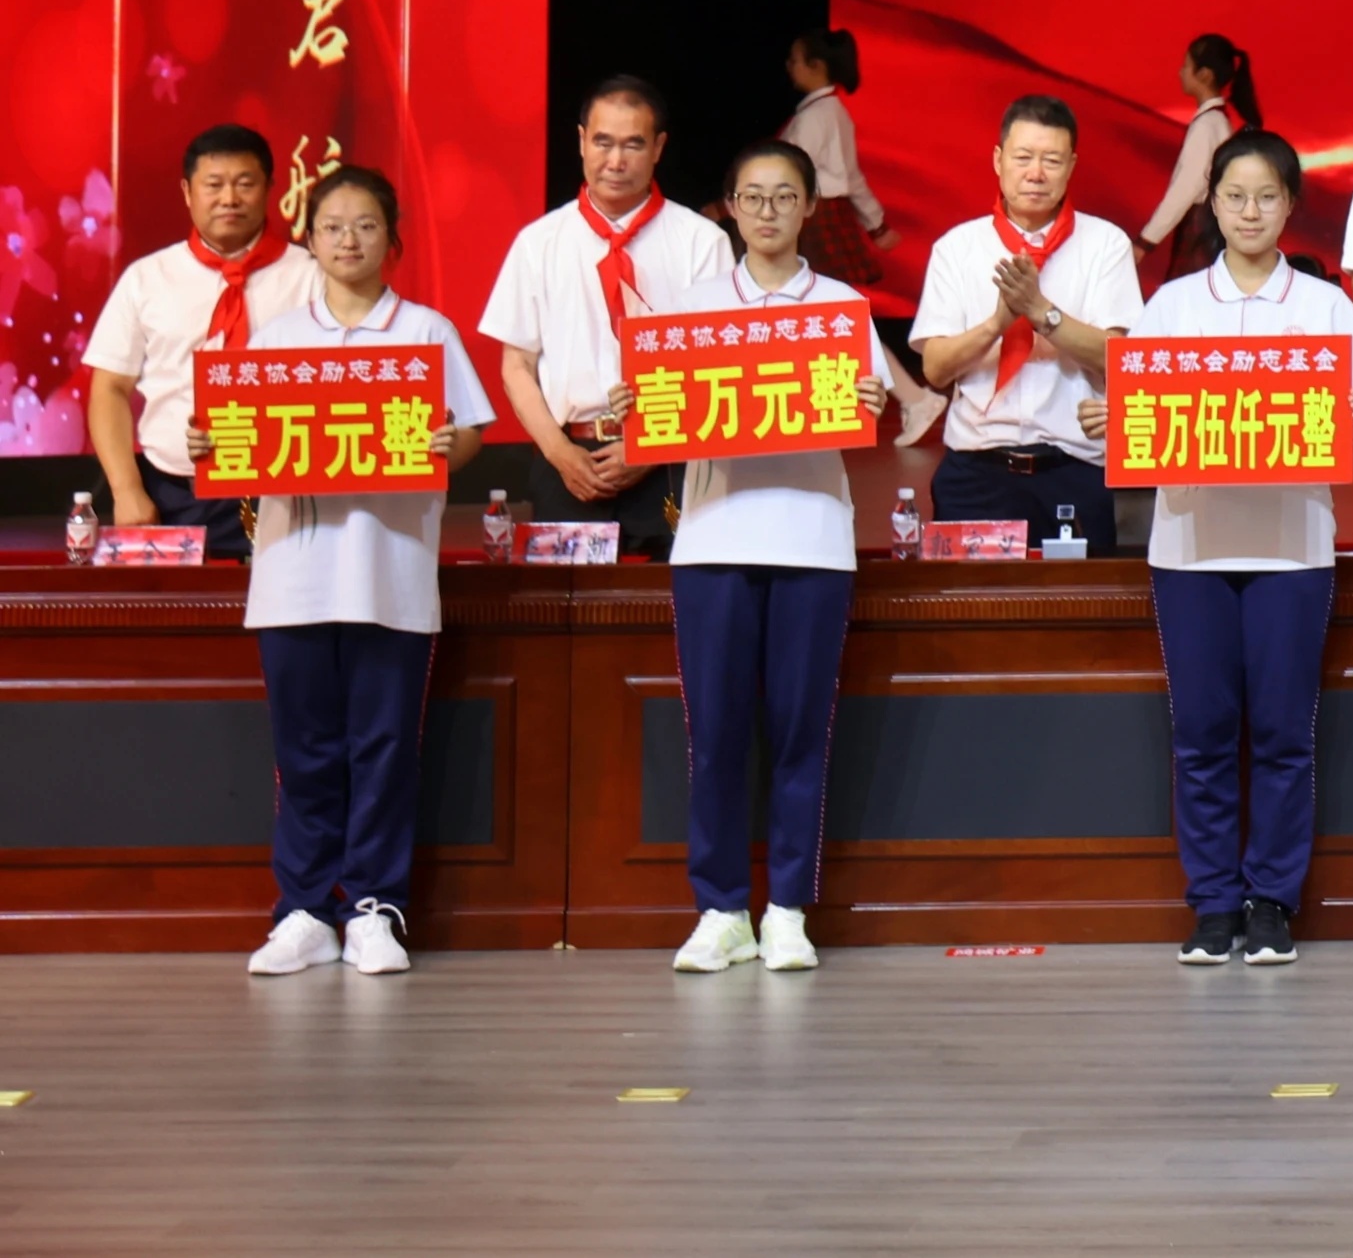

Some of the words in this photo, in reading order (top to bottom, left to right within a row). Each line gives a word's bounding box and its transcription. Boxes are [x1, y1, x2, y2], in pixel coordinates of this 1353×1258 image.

[635, 312, 856, 351] 煤炭协会励志基金
[1120, 346, 1339, 375] 煤炭协会励志基金
[207, 356, 430, 387] 煤炭协会励志基金
[636, 352, 863, 447] 壹万元整
[207, 395, 434, 480] 壹万元整
[1123, 386, 1336, 470] 壹万伍仟元整
